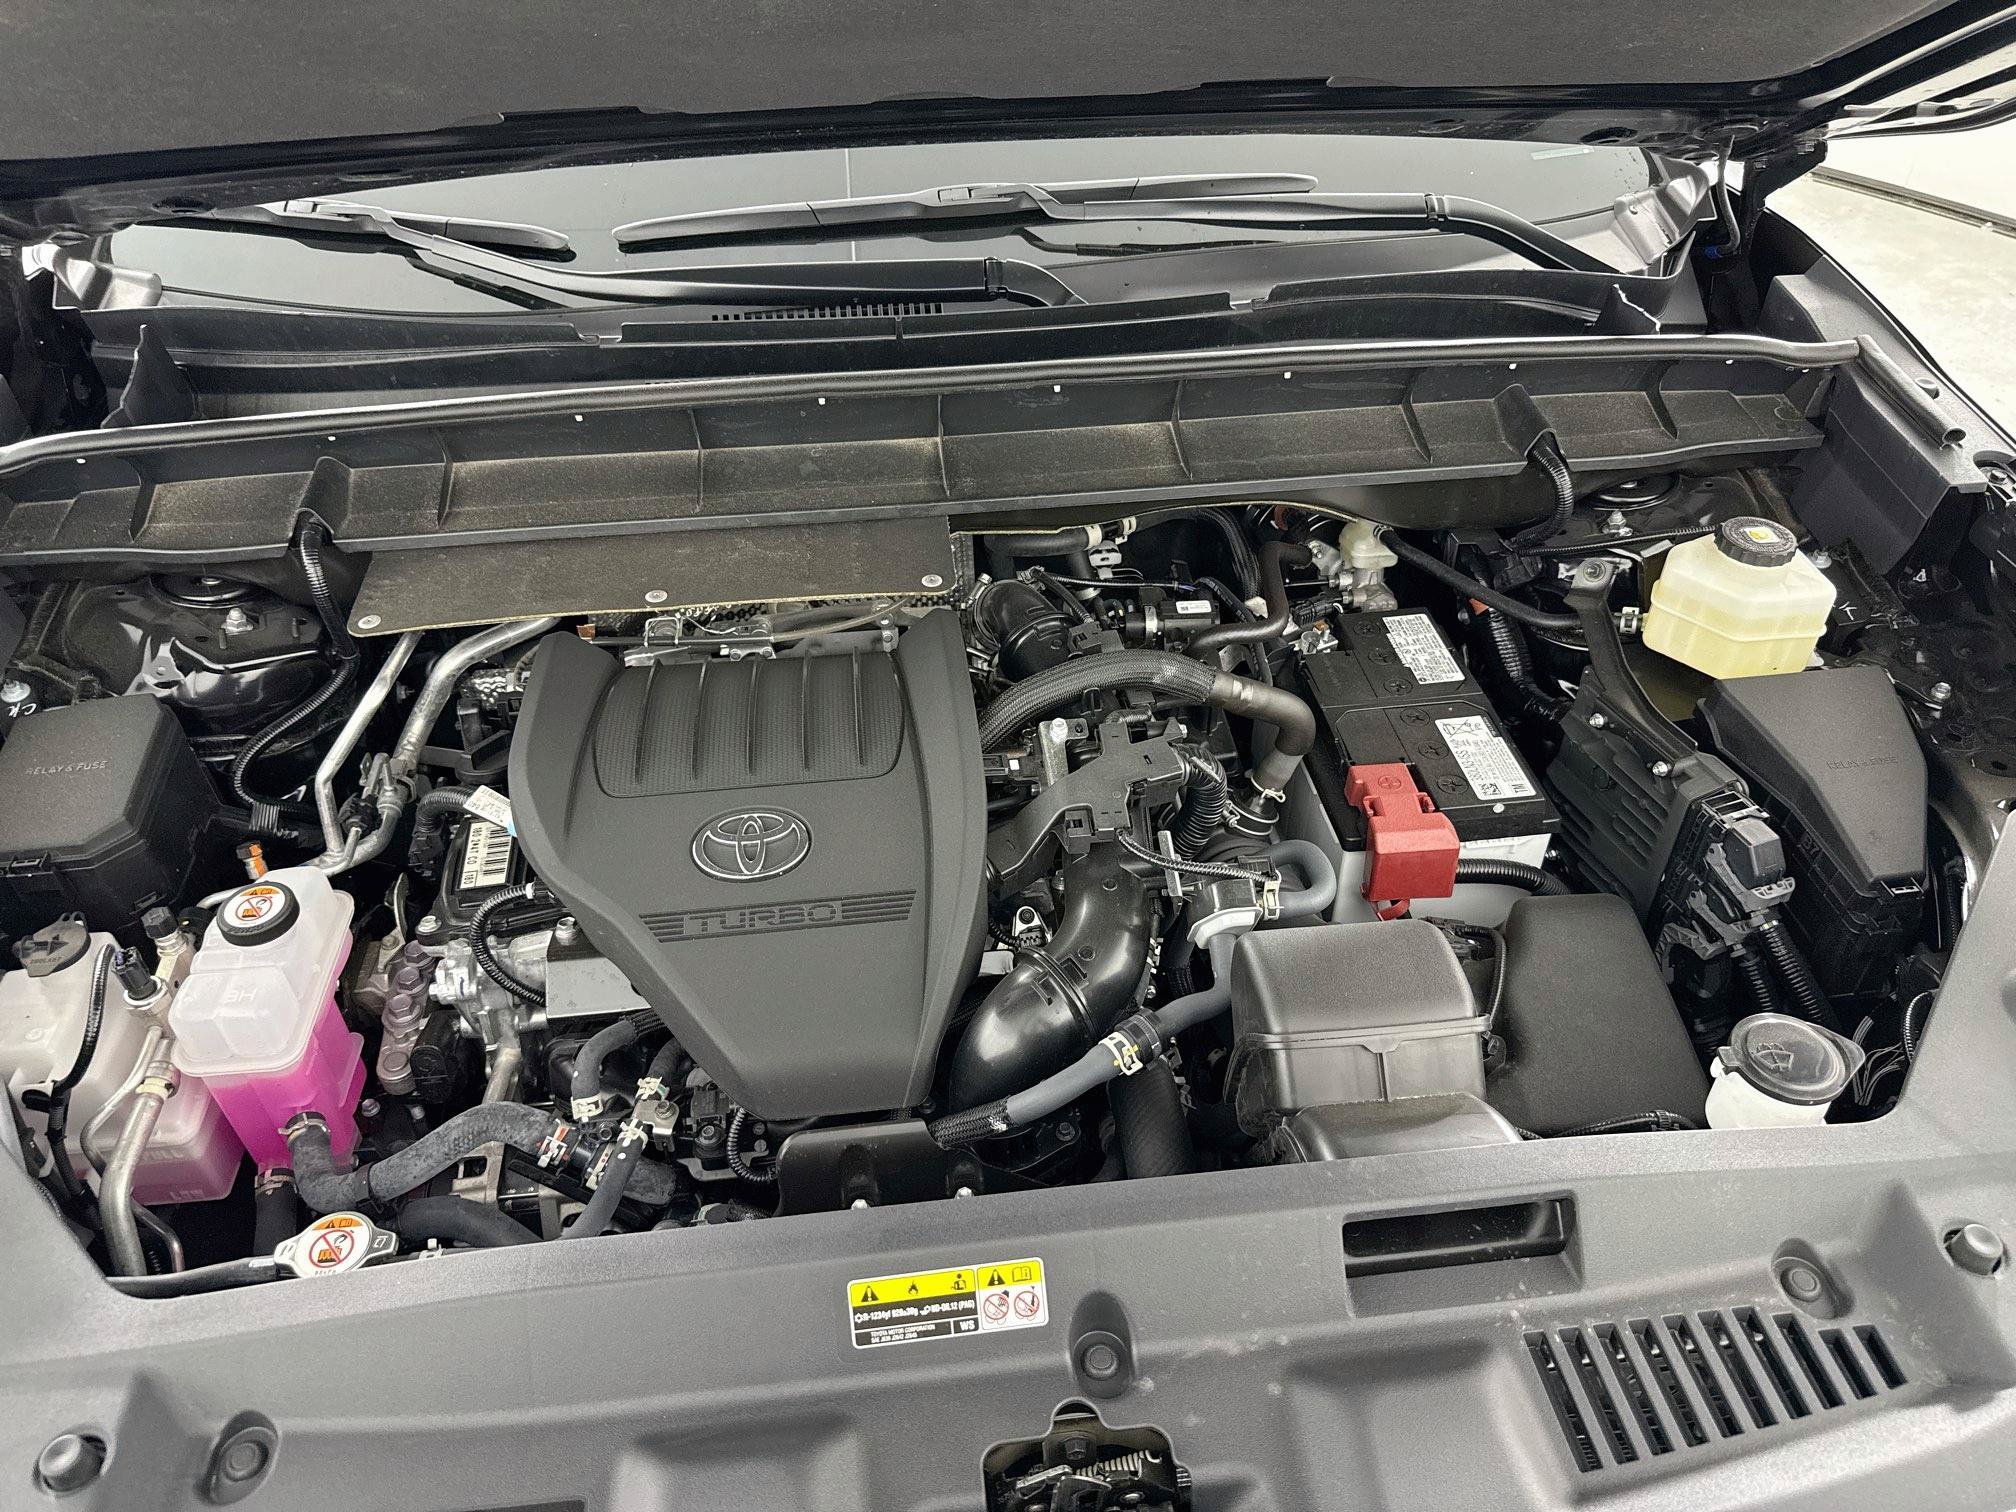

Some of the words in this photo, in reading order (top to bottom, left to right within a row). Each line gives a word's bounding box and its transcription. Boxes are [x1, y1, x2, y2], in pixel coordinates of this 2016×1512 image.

[76, 760, 108, 771] FUSE
[687, 902, 837, 933] TURBO
[870, 1329, 887, 1338] TOYOTA
[887, 1326, 905, 1336] MOTOR
[904, 1323, 936, 1334] CORPORATION
[959, 1320, 976, 1332] WS
